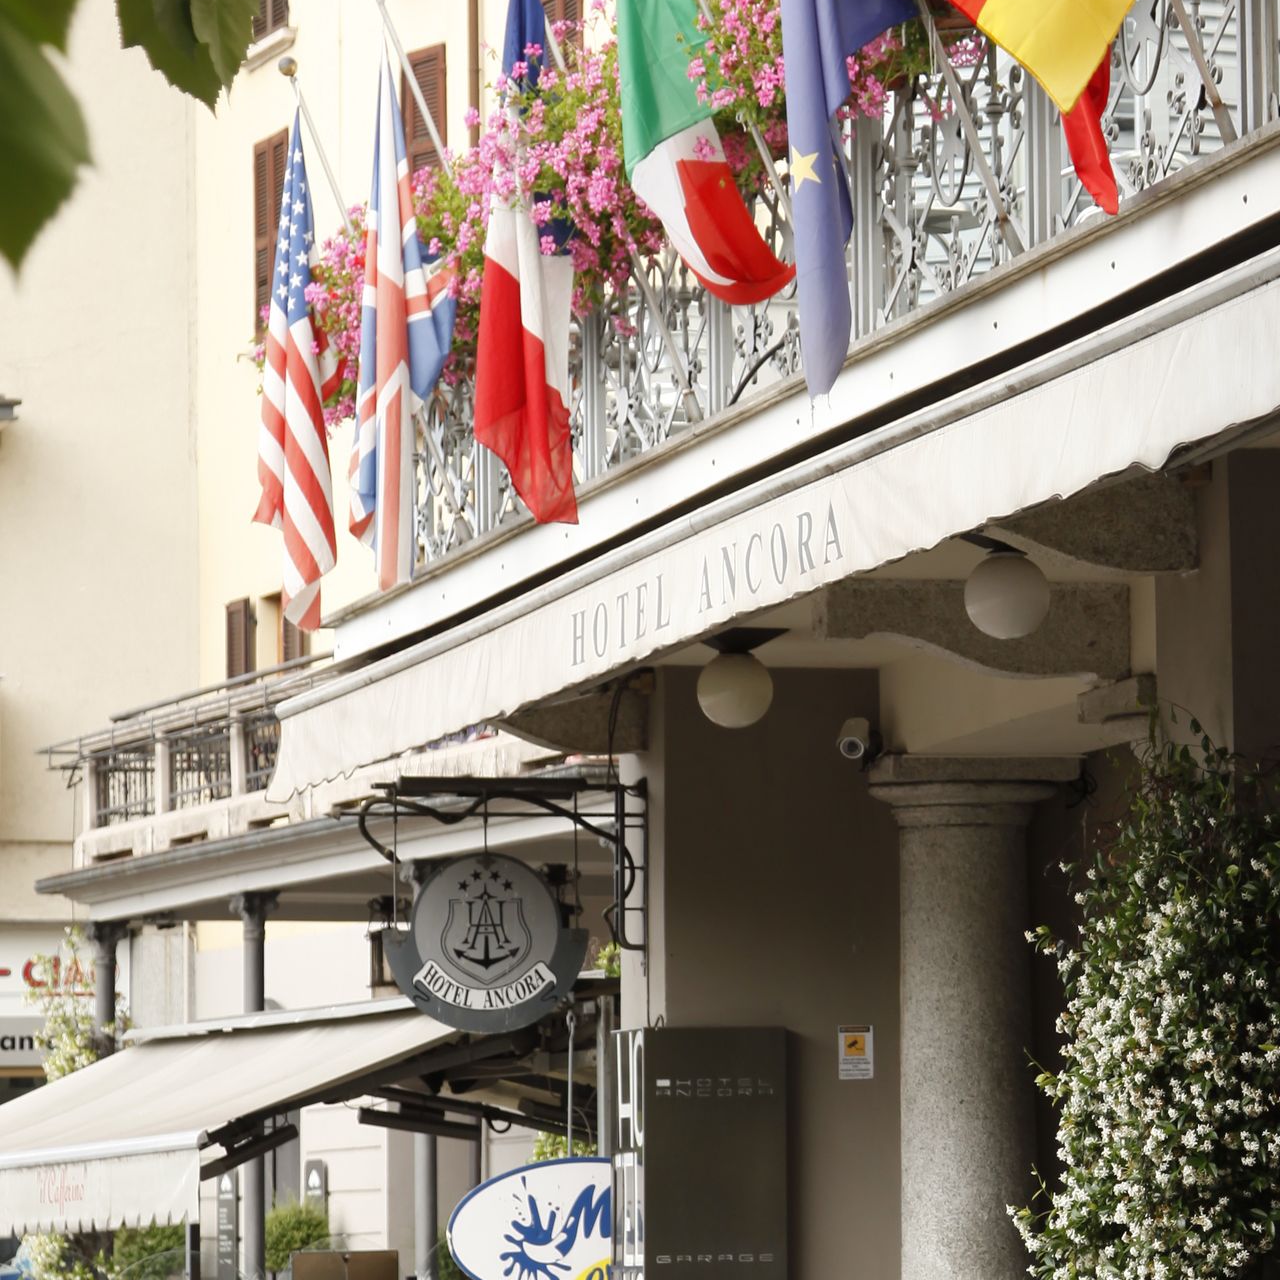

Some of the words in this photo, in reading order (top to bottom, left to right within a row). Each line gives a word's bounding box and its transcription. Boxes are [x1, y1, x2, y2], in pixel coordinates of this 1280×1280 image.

[571, 574, 671, 667] HOTEL
[698, 499, 844, 614] ANCORA
[423, 965, 472, 1008] HOTEL
[483, 968, 546, 1008] ANCORA
[676, 1078, 771, 1088] HOTEL
[656, 1087, 773, 1097] ANCORA
[656, 1253, 773, 1264] GARAGE
